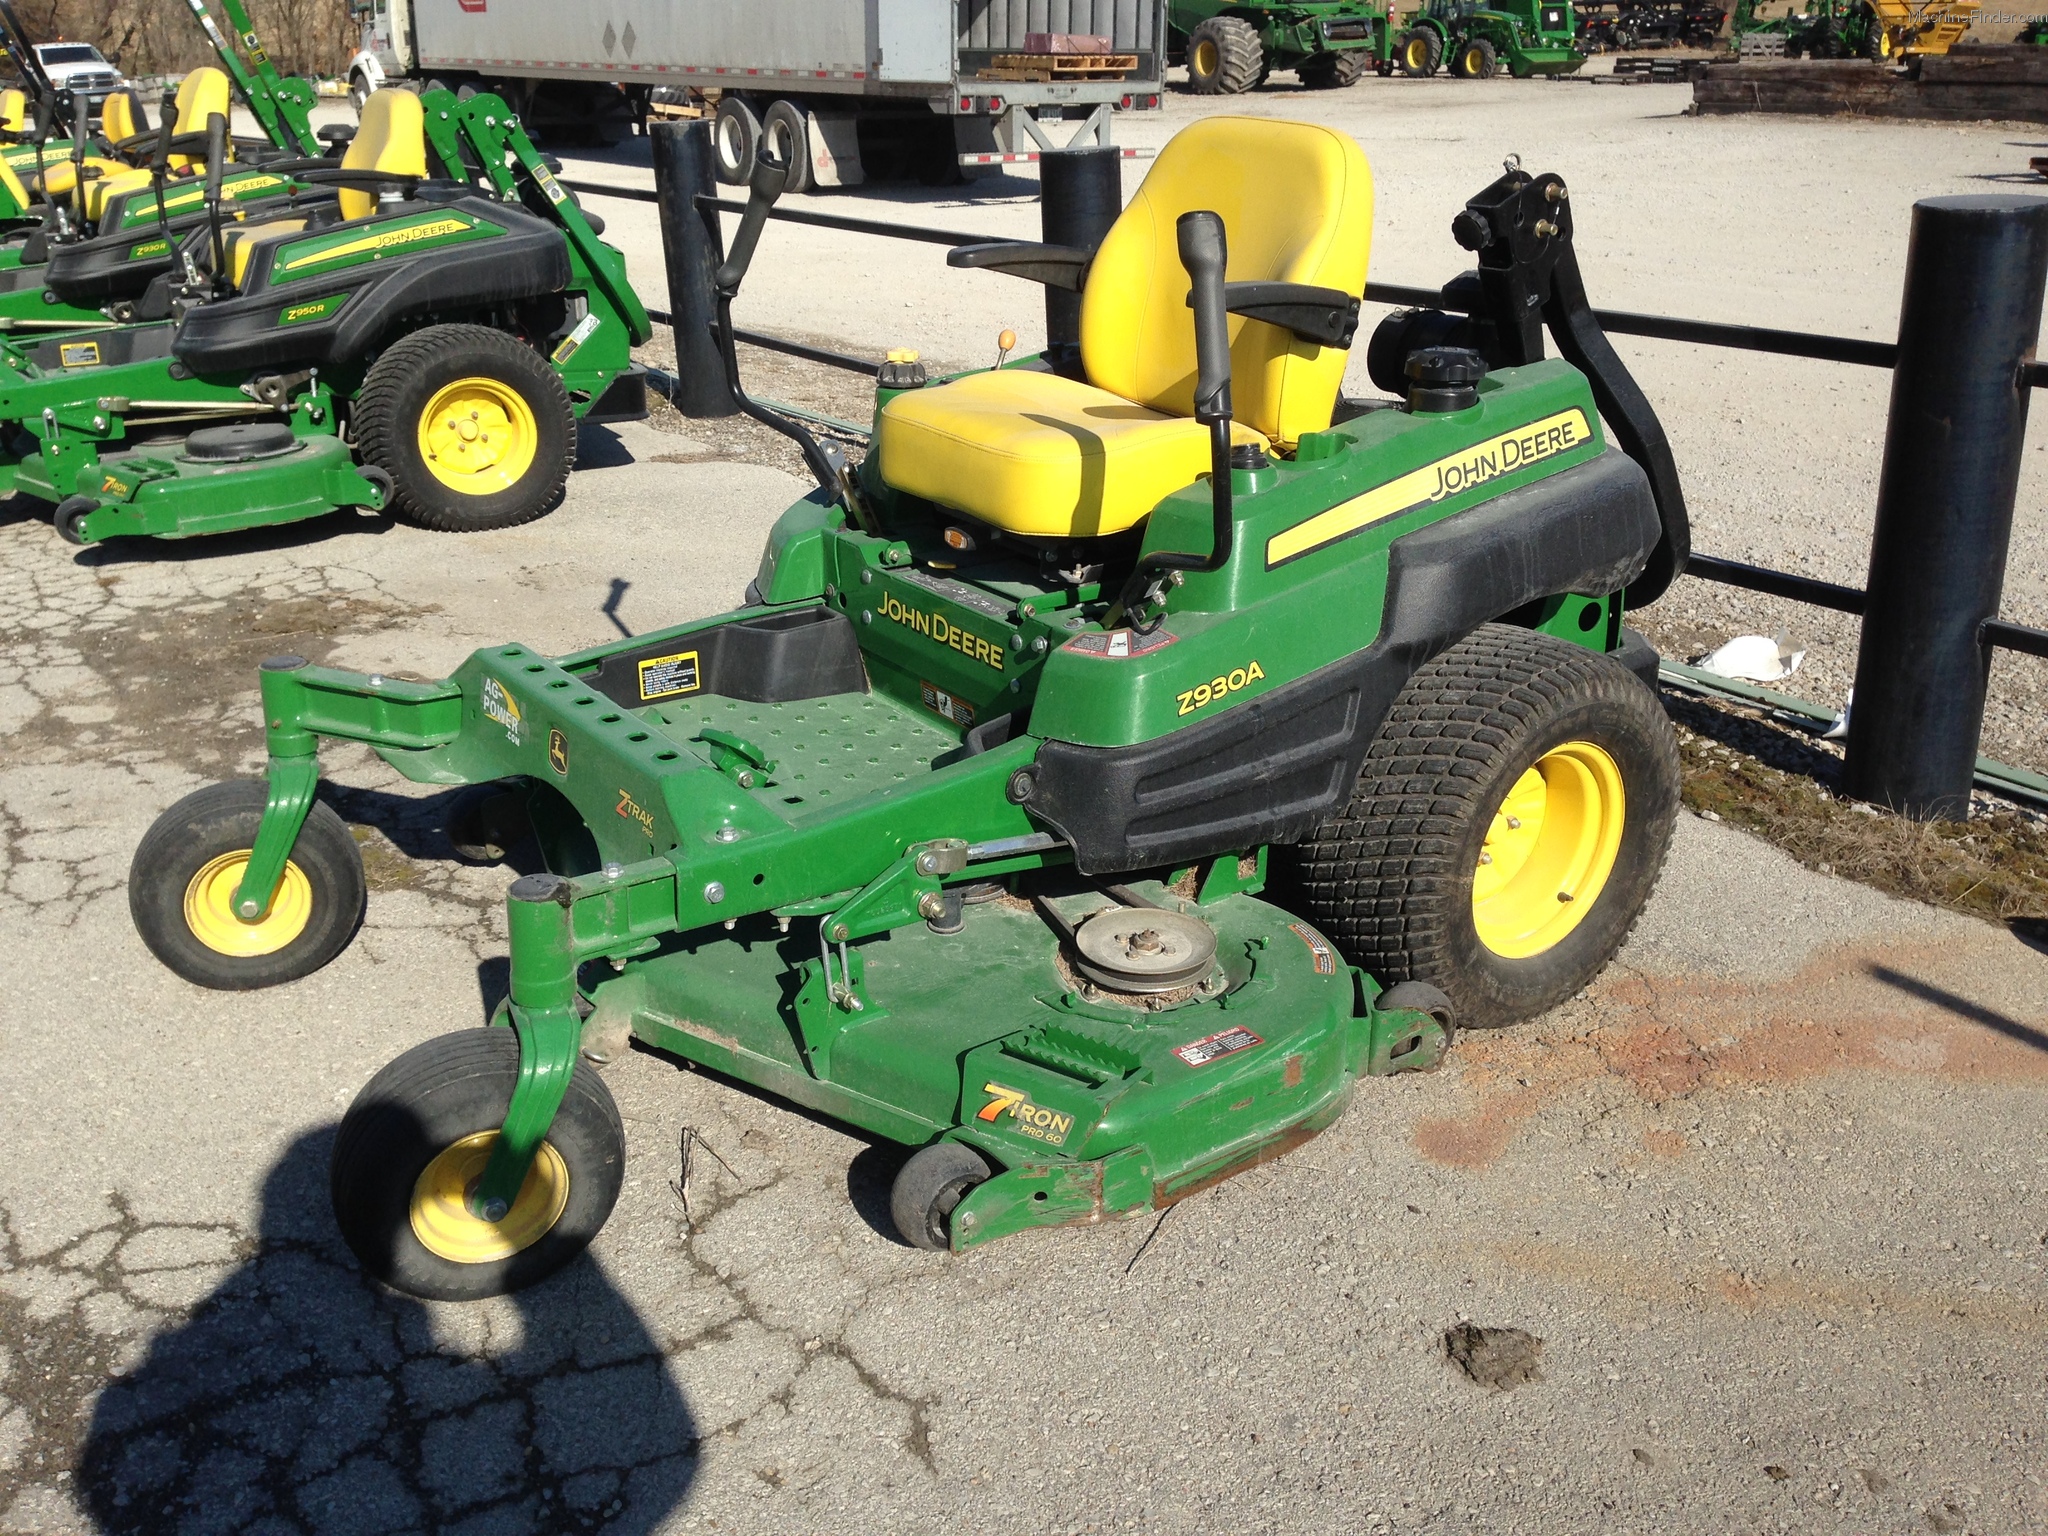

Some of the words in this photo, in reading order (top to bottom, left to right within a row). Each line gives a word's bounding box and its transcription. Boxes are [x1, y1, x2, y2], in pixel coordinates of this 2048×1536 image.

[235, 179, 269, 191] DEERE
[375, 232, 410, 247] JOHN
[412, 223, 454, 239] DEERE
[136, 243, 166, 256] Z930R
[287, 304, 325, 320] Z950R
[1430, 451, 1497, 498] JOHN
[1501, 421, 1575, 468] DEERE
[877, 590, 930, 636] JOHN
[932, 612, 1004, 670] DEERE
[484, 678, 503, 699] AG-
[1176, 660, 1266, 717] Z930A
[483, 694, 518, 734] POWER
[505, 731, 520, 747] .COM
[641, 825, 654, 838] PRO
[1020, 1124, 1044, 1138] PRO
[1045, 1132, 1062, 1144] 60
